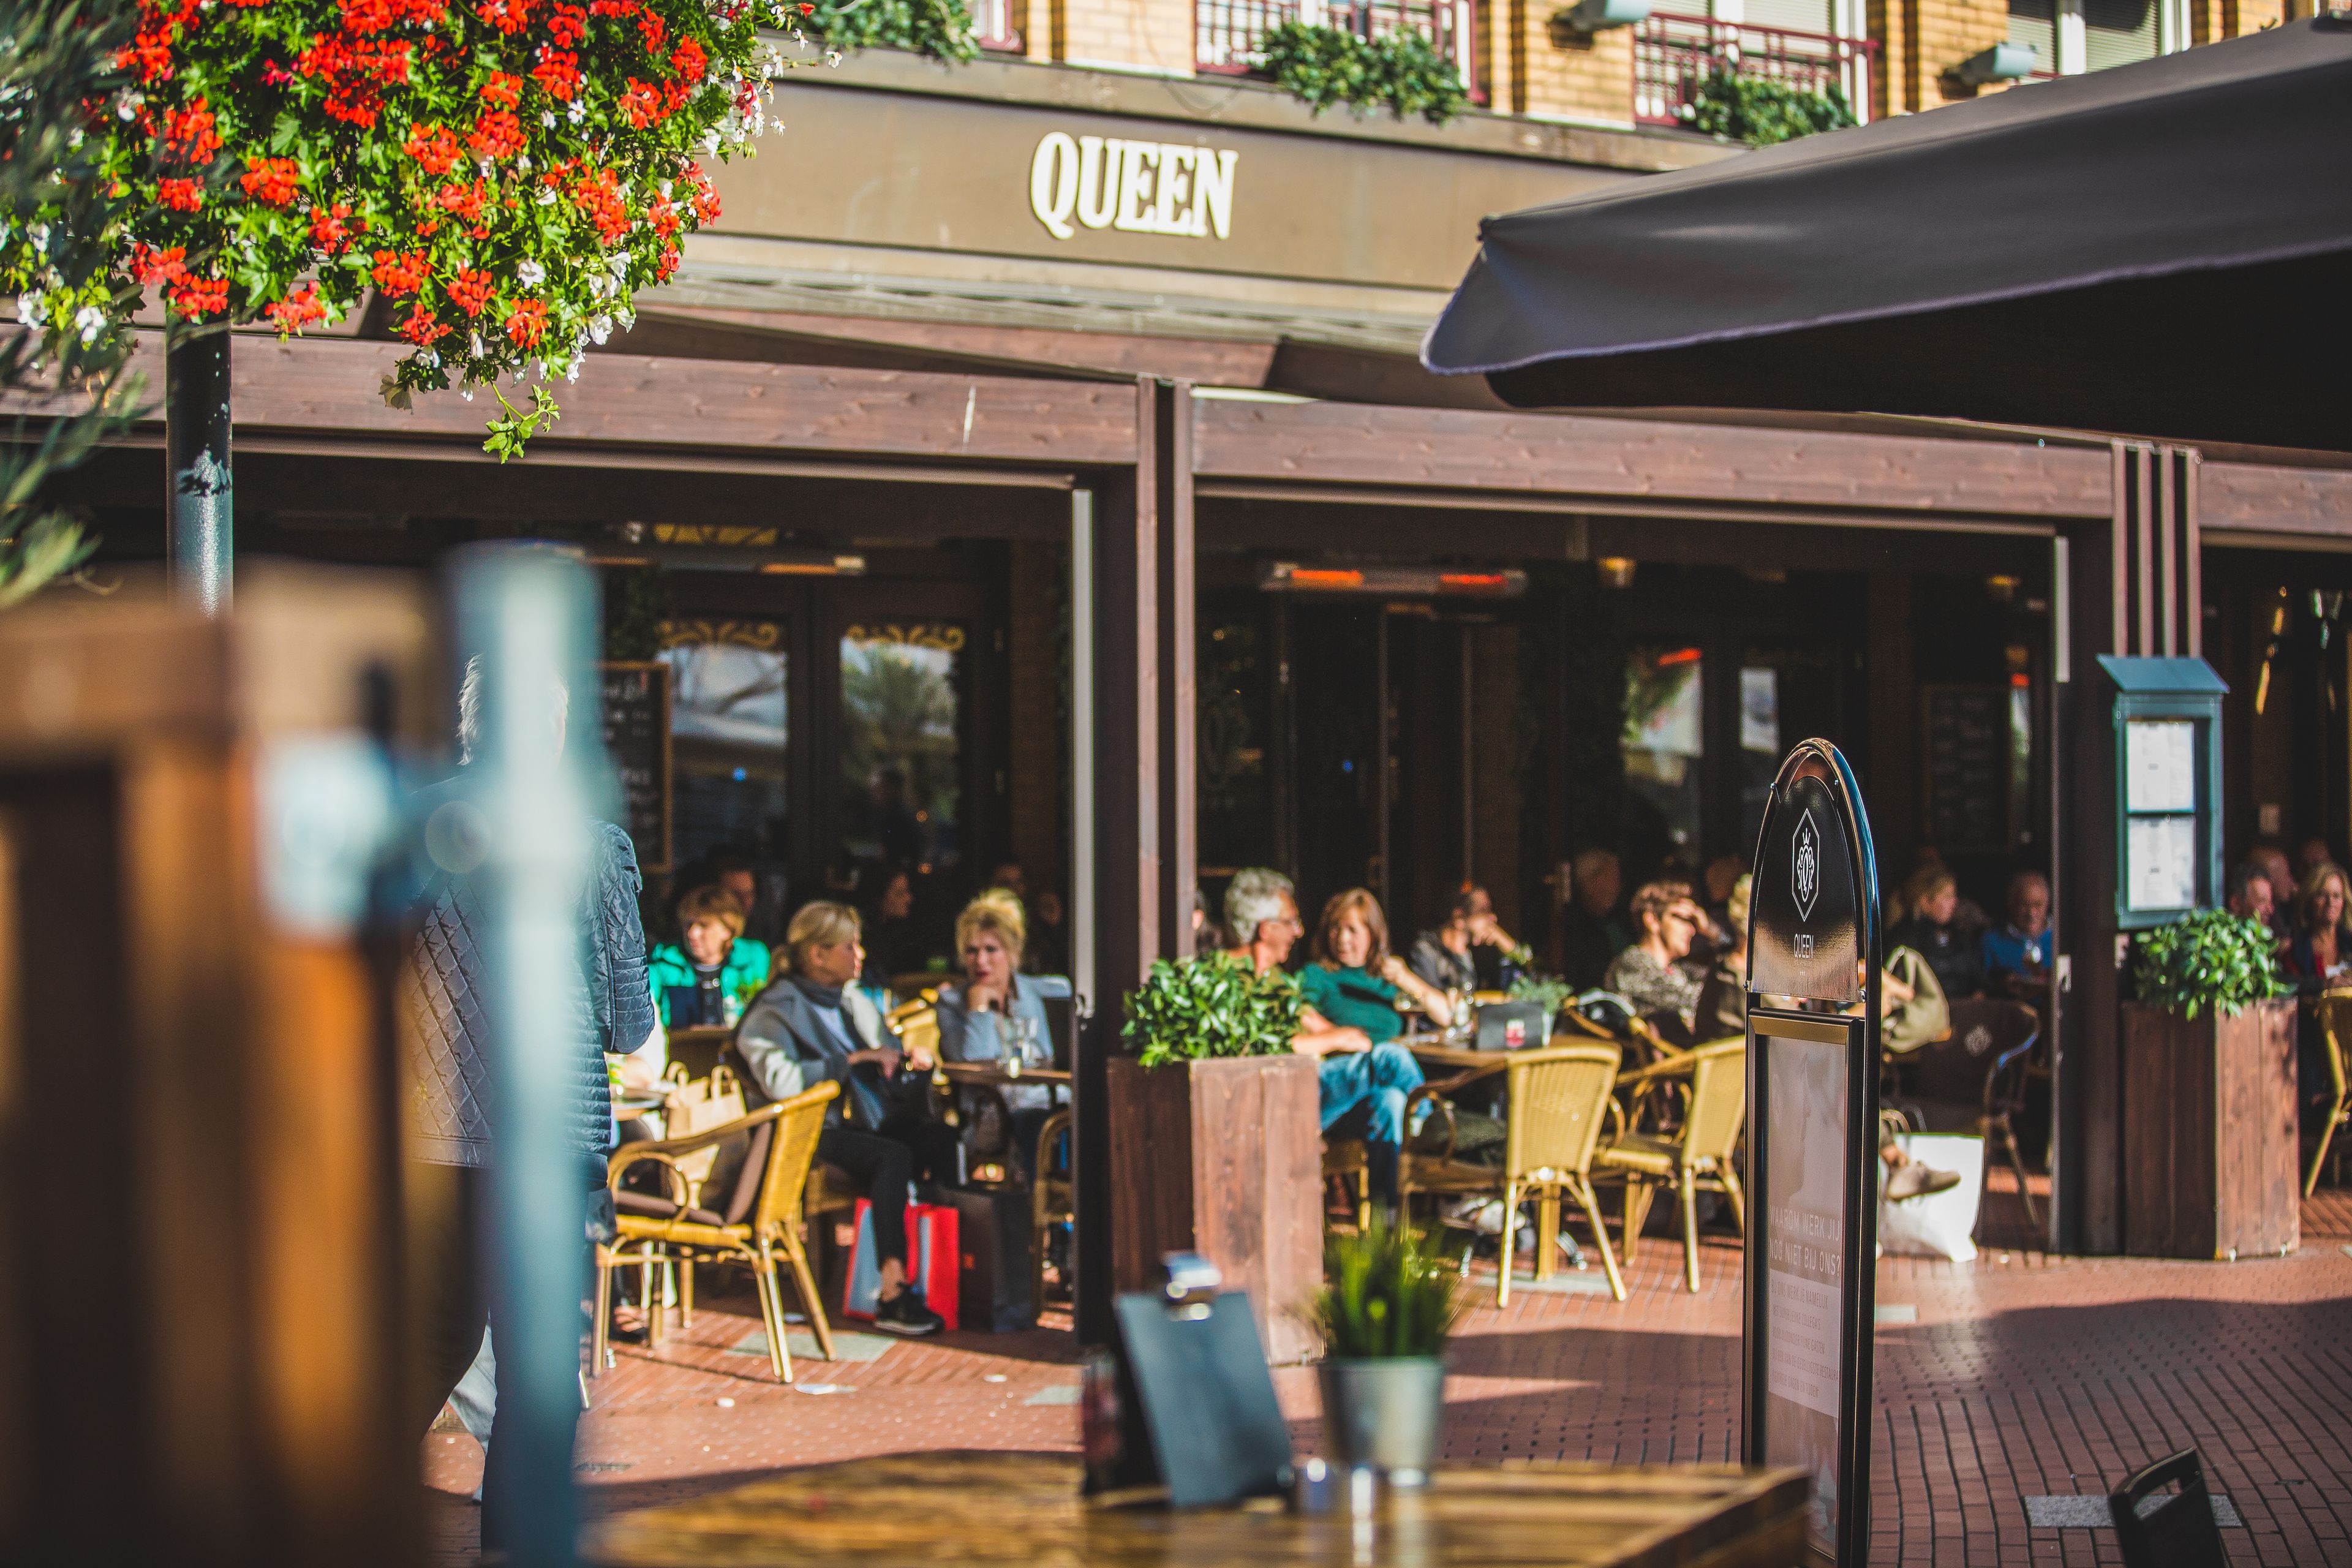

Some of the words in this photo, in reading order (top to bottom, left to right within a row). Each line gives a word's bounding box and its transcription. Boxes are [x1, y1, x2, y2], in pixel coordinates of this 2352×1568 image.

[1030, 132, 1239, 239] QUEEN
[1793, 933, 1814, 959] QUEEN
[1769, 1205, 1800, 1232] WAAROM
[1802, 1212, 1825, 1238] WERK
[1827, 1219, 1840, 1241] JIJ
[1769, 1237, 1783, 1261] NOG
[1785, 1242, 1802, 1266] NIET
[1804, 1247, 1817, 1270] BIJ
[1819, 1251, 1841, 1276] ONS?
[1806, 1289, 1828, 1310] NAMELIJK
